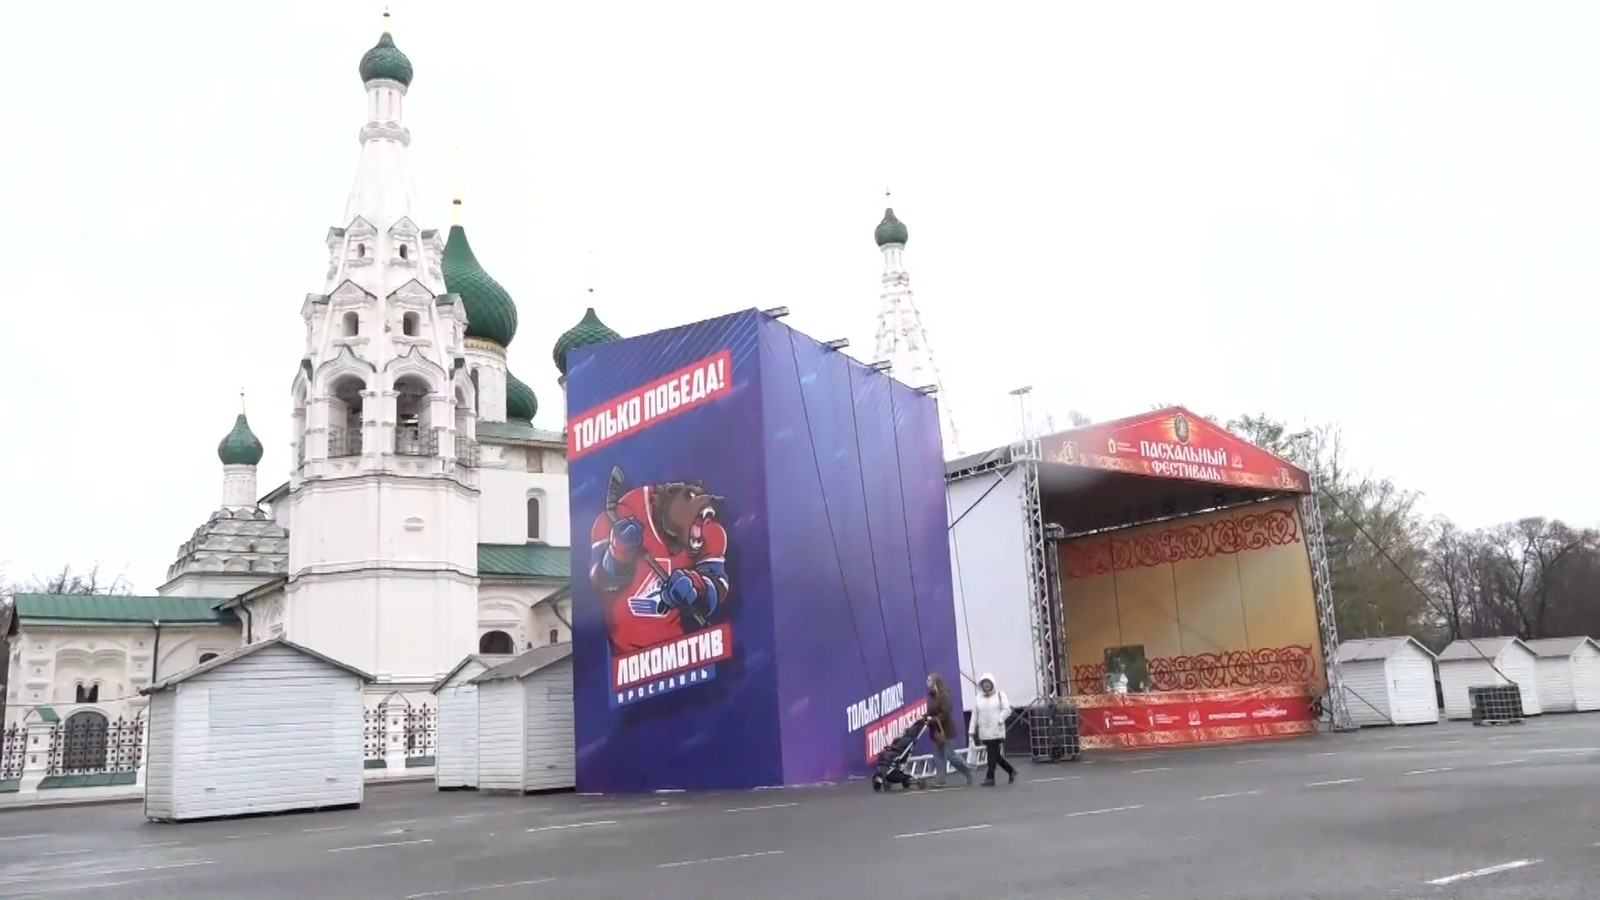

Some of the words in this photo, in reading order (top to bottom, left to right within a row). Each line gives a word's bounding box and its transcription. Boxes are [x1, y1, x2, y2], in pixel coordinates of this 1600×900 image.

[573, 396, 641, 452] ТОЛЬКО
[643, 358, 725, 422] ПОБЕДА!
[1140, 440, 1227, 467] ПАСХАЛЬНЫЙ
[1151, 461, 1221, 480] ФЕСТИВАЛЬ
[617, 629, 724, 686] ЛОКОМОТИВ
[618, 669, 707, 703] ЯРОСЛАВЛЬ
[846, 693, 880, 733] ТОЛЬКО
